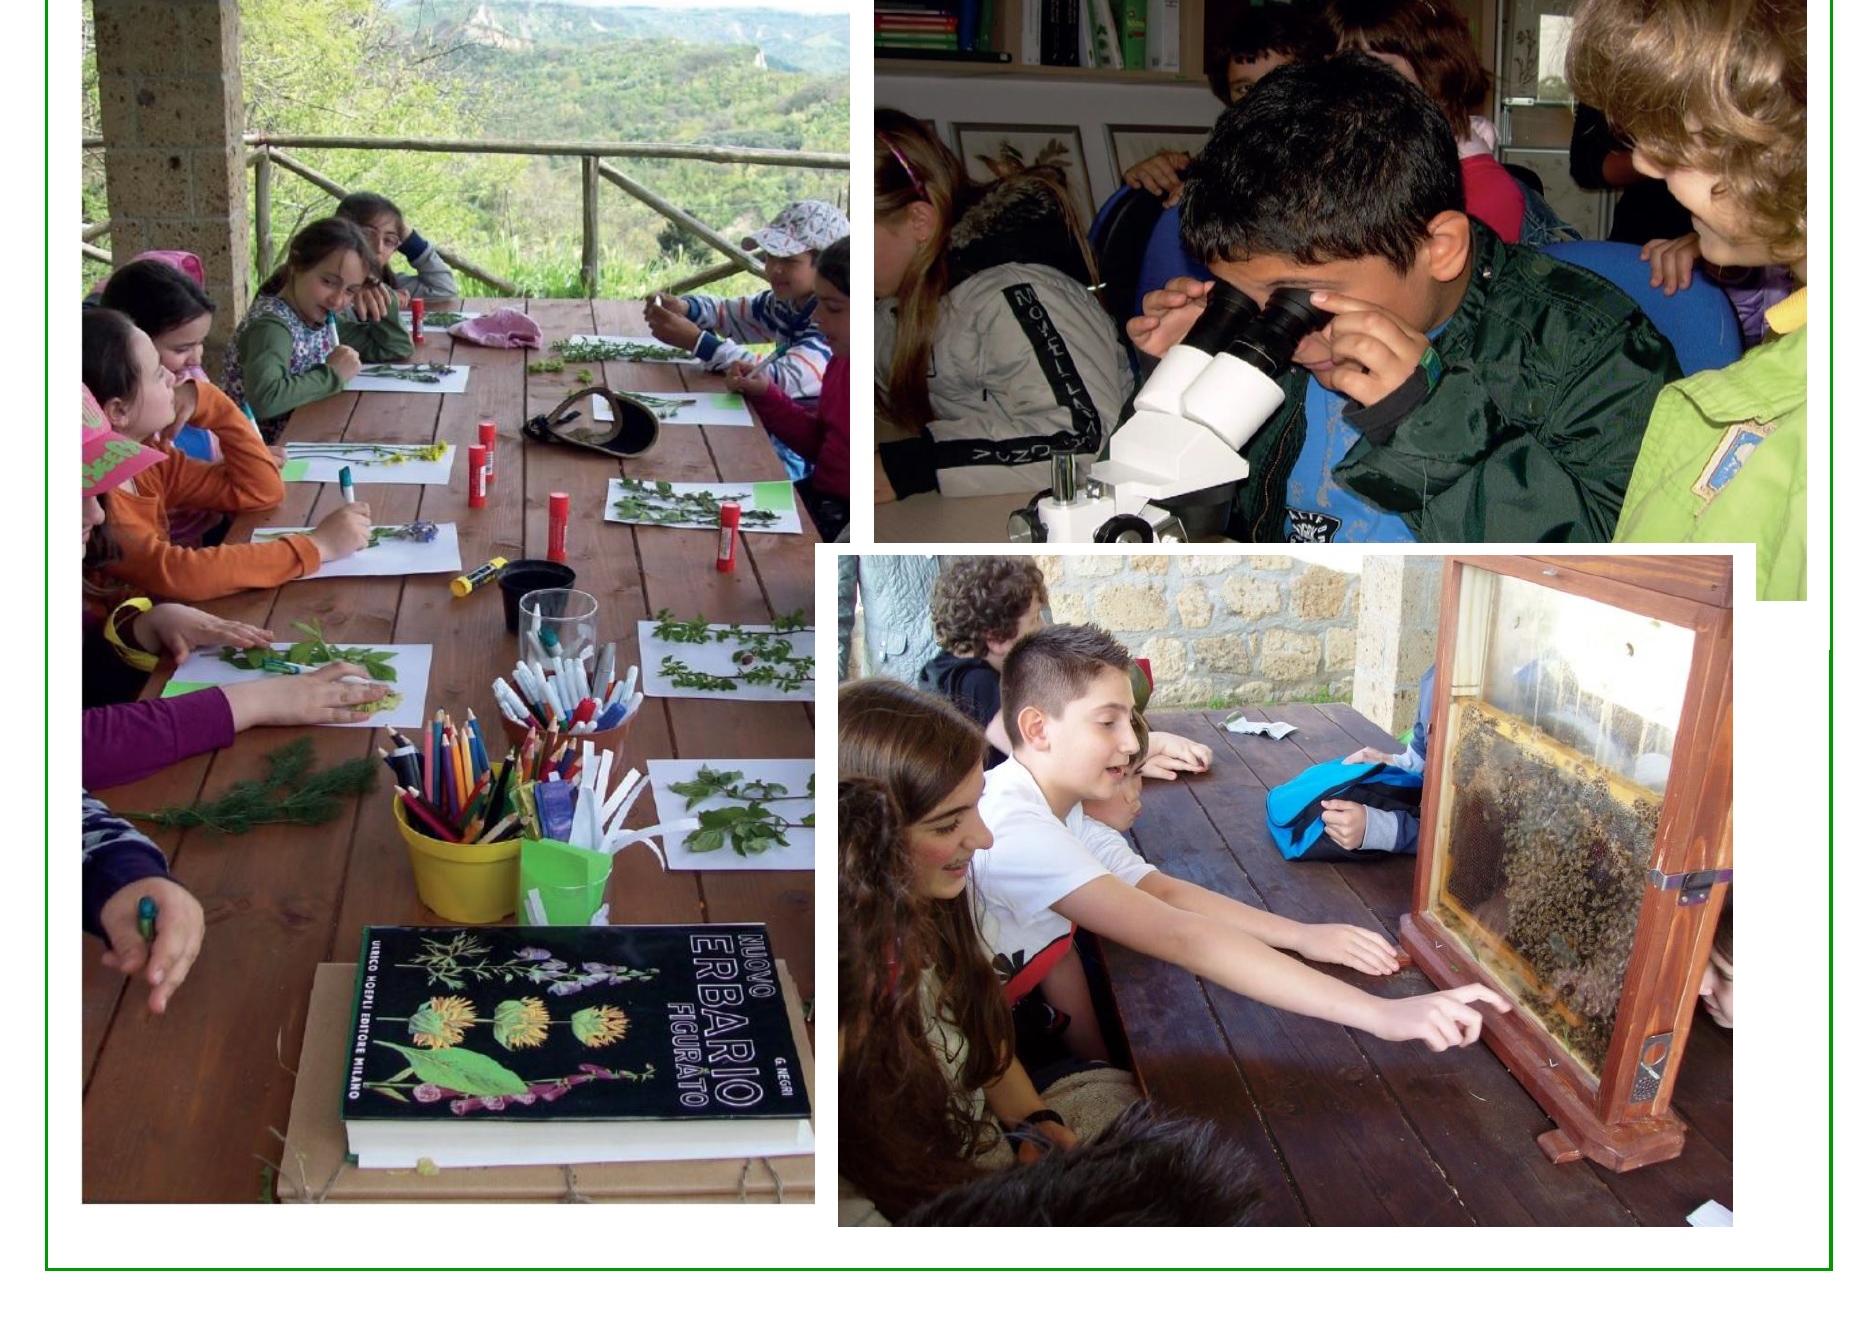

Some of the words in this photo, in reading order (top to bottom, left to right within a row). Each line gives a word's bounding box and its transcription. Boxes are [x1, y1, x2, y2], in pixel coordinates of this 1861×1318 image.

[367, 940, 382, 972] ULRICO
[738, 934, 776, 998] NUOVO
[362, 975, 377, 1010] HOEPLI
[355, 1013, 371, 1054] EDITORE
[690, 934, 764, 1107] ERBARIO
[667, 1002, 709, 1108] FIGURATO
[348, 1057, 365, 1100] MILANO
[776, 1068, 794, 1097] NEGRI
